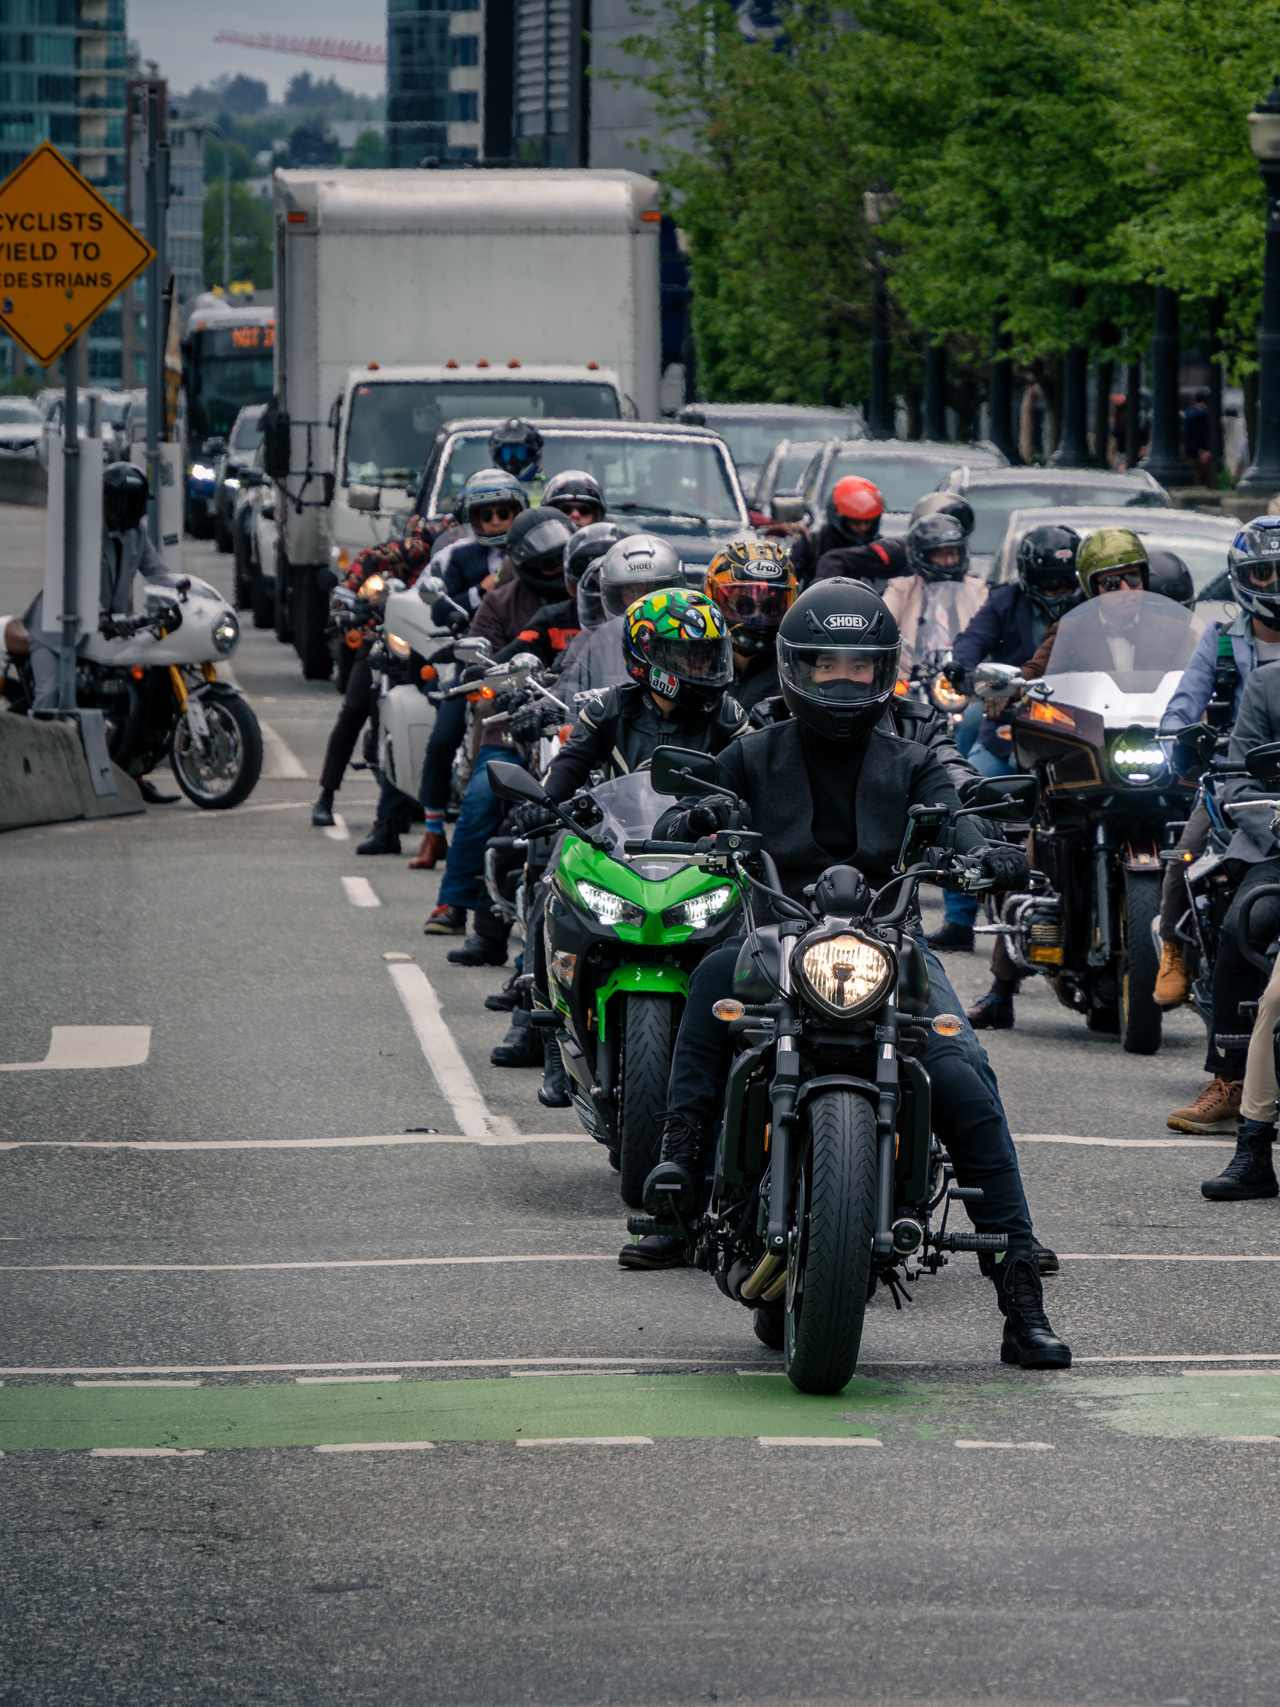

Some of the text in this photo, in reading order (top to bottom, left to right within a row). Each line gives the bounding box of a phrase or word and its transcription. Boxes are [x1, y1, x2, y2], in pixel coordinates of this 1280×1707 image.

[0, 212, 103, 231] YCLISTS
[70, 242, 100, 261] TO
[0, 272, 112, 288] DESTRIANS
[628, 562, 652, 571] SHOEI
[749, 561, 777, 573] Arai
[829, 616, 863, 627] SHOEI
